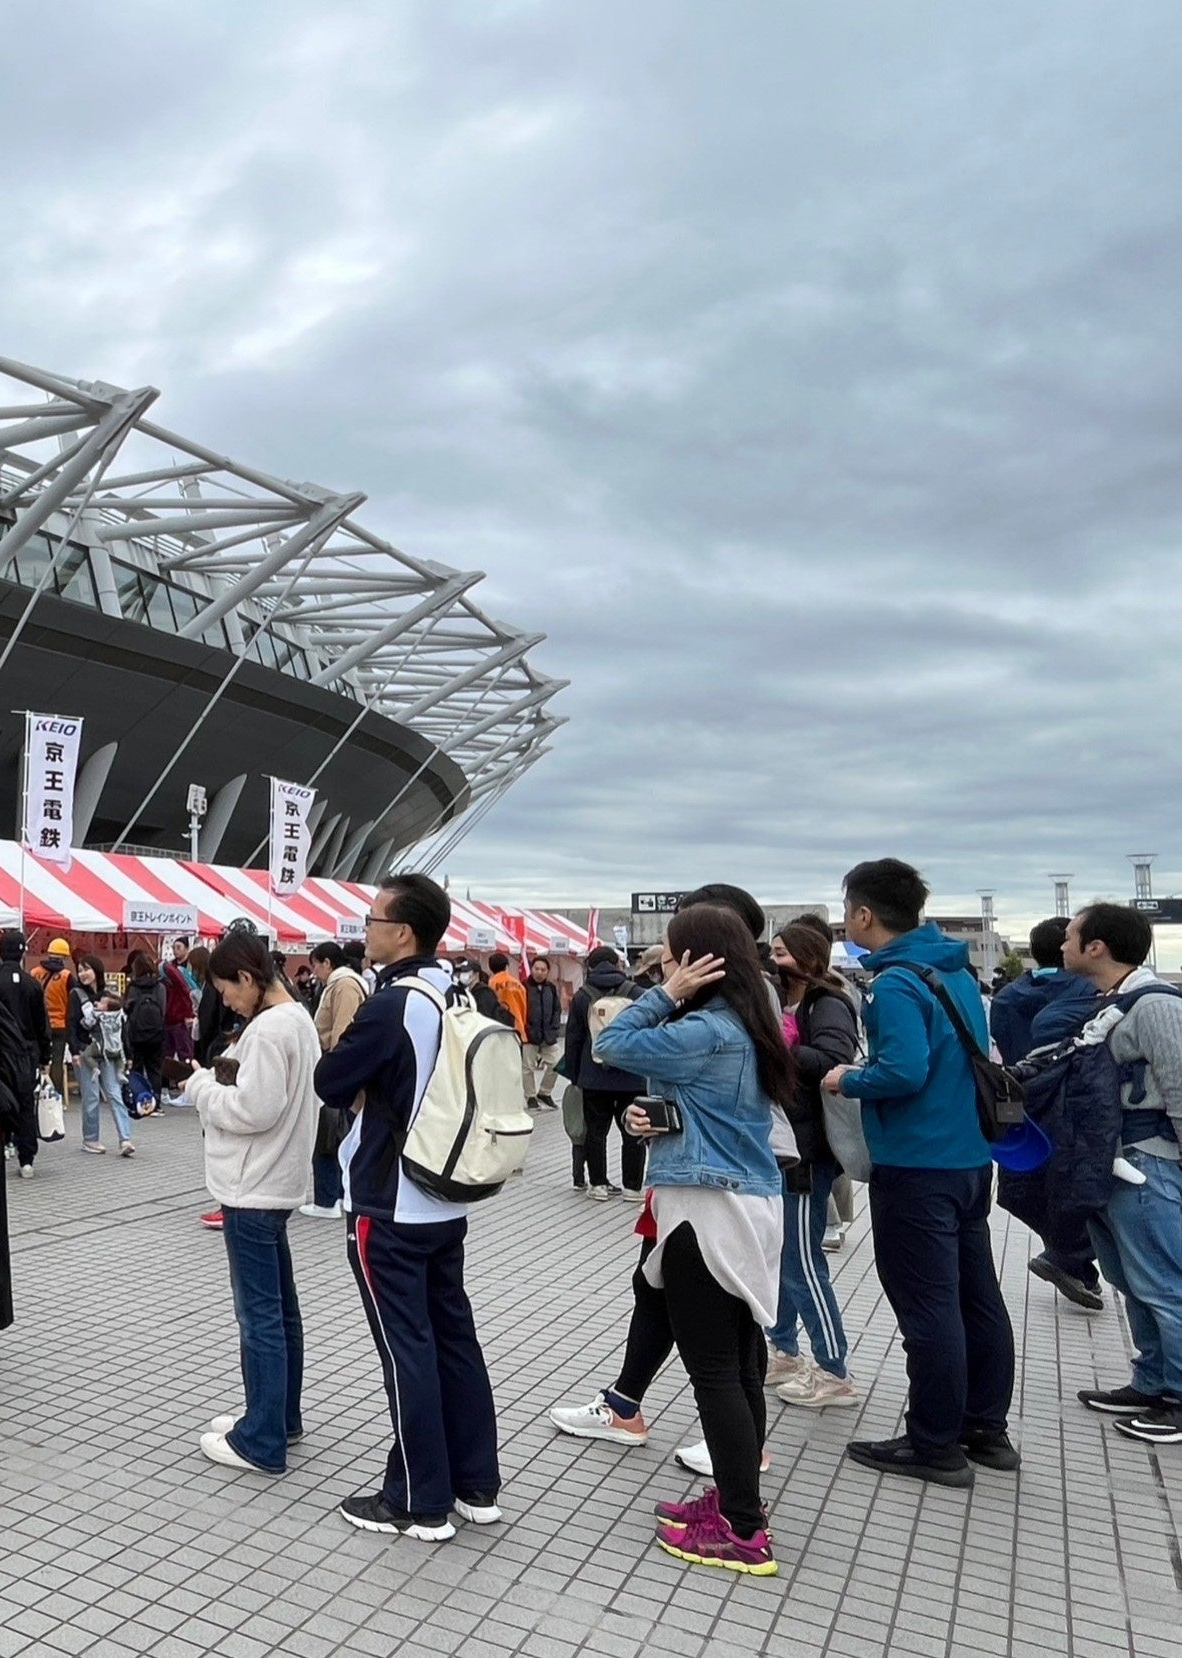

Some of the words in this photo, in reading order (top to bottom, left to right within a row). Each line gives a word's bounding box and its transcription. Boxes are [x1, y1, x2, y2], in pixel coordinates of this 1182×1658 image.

[35, 719, 77, 737] KEIO
[39, 741, 65, 849] 京王電鉄
[278, 783, 311, 799] KEIO
[280, 800, 300, 884] 京王電鉄
